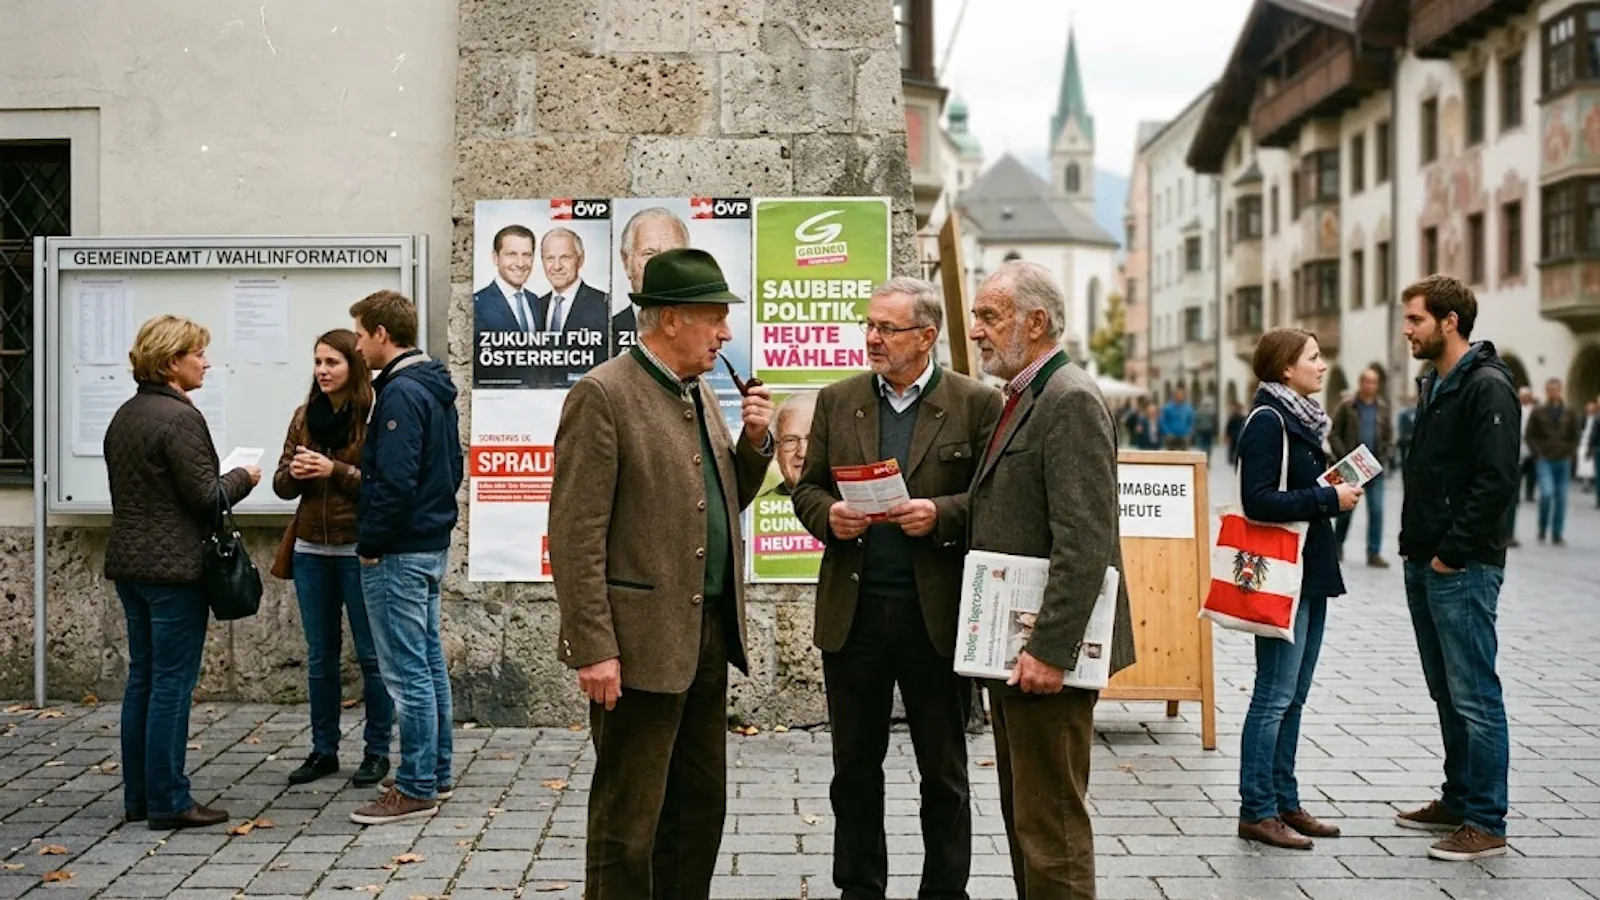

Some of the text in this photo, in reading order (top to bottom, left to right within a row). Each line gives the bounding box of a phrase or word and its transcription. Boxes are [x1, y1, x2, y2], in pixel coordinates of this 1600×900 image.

[574, 201, 607, 216] ÖVP
[714, 201, 747, 215] ÖVP
[73, 251, 201, 265] GEMEINDEAMT
[216, 249, 387, 264] WAHLINFORMATION
[763, 280, 872, 299] SAUBERE
[763, 302, 863, 321] POLITIK.
[479, 328, 603, 347] ZUKUNFT FÜR
[763, 326, 840, 343] HEUTE
[479, 347, 594, 366] ÖSTERREICH
[1119, 504, 1162, 517] HEUTE
[760, 535, 814, 551] HEUTE
